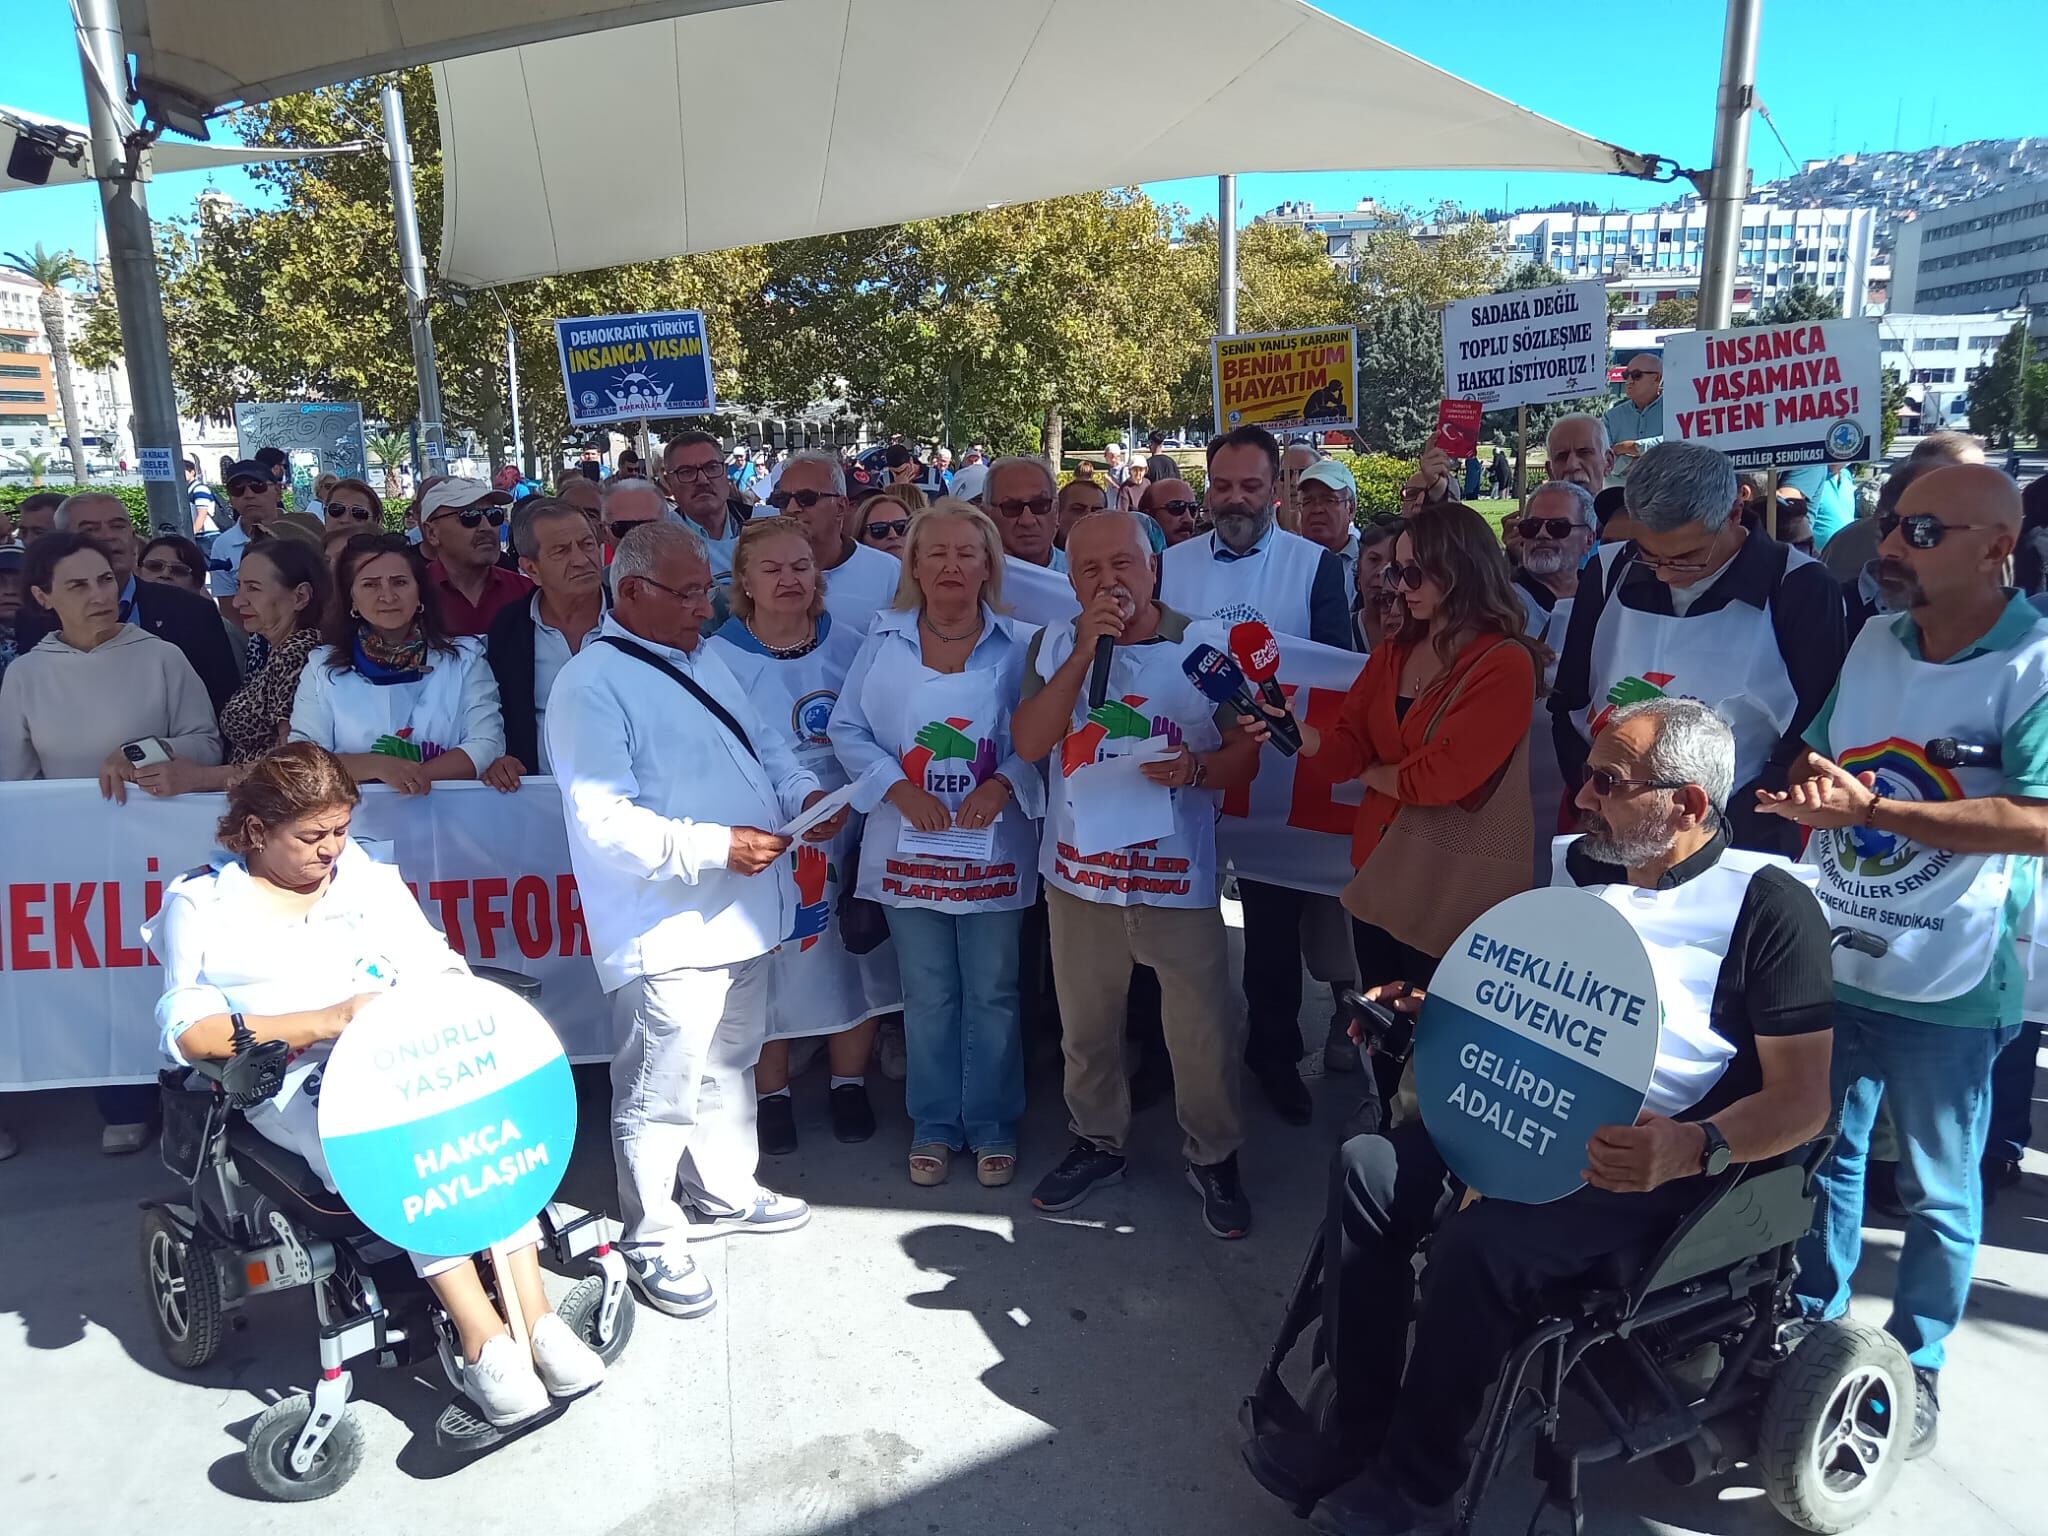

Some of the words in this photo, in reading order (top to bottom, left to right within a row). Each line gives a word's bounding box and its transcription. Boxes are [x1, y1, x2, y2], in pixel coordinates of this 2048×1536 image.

[1471, 300, 1531, 327] SADAKA
[1533, 288, 1579, 318] DEĞİL
[570, 322, 649, 347] DEMOKRATİK
[650, 319, 696, 337] TÜRKİYE
[1221, 344, 1256, 356] SENİN
[1259, 337, 1298, 351] YANLIŞ
[1300, 331, 1349, 346] KARARIN
[1459, 332, 1509, 360] TOPLU
[1512, 322, 1592, 353] SÖZLEŞME
[1705, 325, 1827, 370] İNSANCA
[568, 342, 647, 374] İNSANCA
[648, 337, 702, 361] YAŞAM
[1222, 352, 1292, 381] BENİM
[1297, 345, 1345, 369] TÜM
[1457, 367, 1506, 393] HAKKI
[1508, 355, 1587, 385] İSTİYORUZ
[1224, 368, 1328, 406] HAYATIM
[1692, 356, 1842, 404] YAŞAMAYA
[1676, 400, 1765, 440] YETEN
[1774, 386, 1859, 427] MAAŞ!
[1728, 451, 1773, 466] MEKLİLER
[1776, 448, 1824, 463] SENDİKASI
[927, 770, 971, 792] İZEP
[882, 877, 1018, 901] PLATFORMU
[886, 858, 1017, 882] EMEKLİLER
[1055, 858, 1191, 895] PLATFORMU
[1823, 858, 1893, 899] EMEKLİLER
[1896, 849, 1953, 895] SENDİK
[1878, 911, 1944, 932] SENDİKASI
[1467, 933, 1646, 1026] EMEKLİLİKTE
[1476, 980, 1607, 1057] GÜVENCE
[373, 1015, 497, 1071] ONURLU
[396, 1051, 497, 1101] YAŞAM
[1460, 1043, 1576, 1121] GELİRDE
[1447, 1082, 1557, 1157] ADALET
[413, 1119, 522, 1180] HAKÇA
[402, 1142, 549, 1225] PAYLAŞIM
